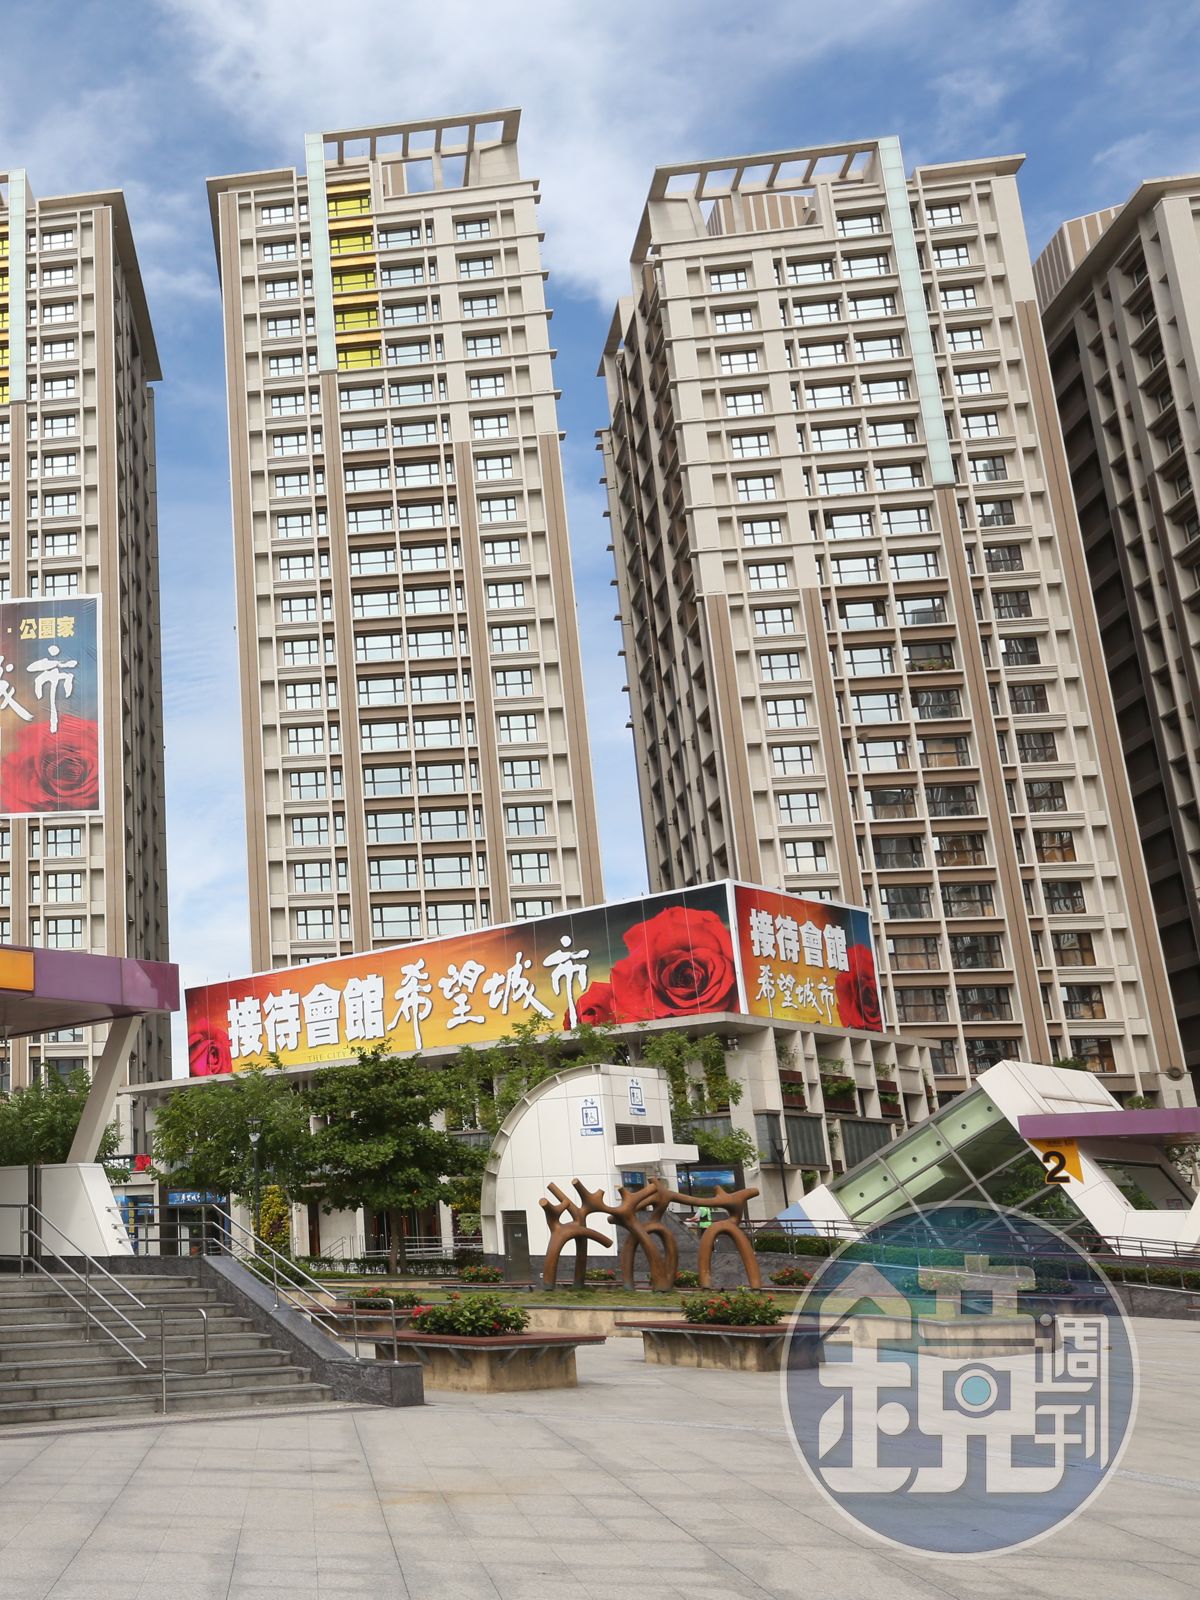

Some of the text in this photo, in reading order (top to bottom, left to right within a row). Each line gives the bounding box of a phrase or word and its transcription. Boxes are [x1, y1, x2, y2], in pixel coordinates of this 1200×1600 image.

[749, 908, 850, 972] 接待會館
[227, 935, 590, 1059] 接待會館 希望城市
[756, 964, 834, 1024] 希望城市
[1042, 1151, 1071, 1184] 2
